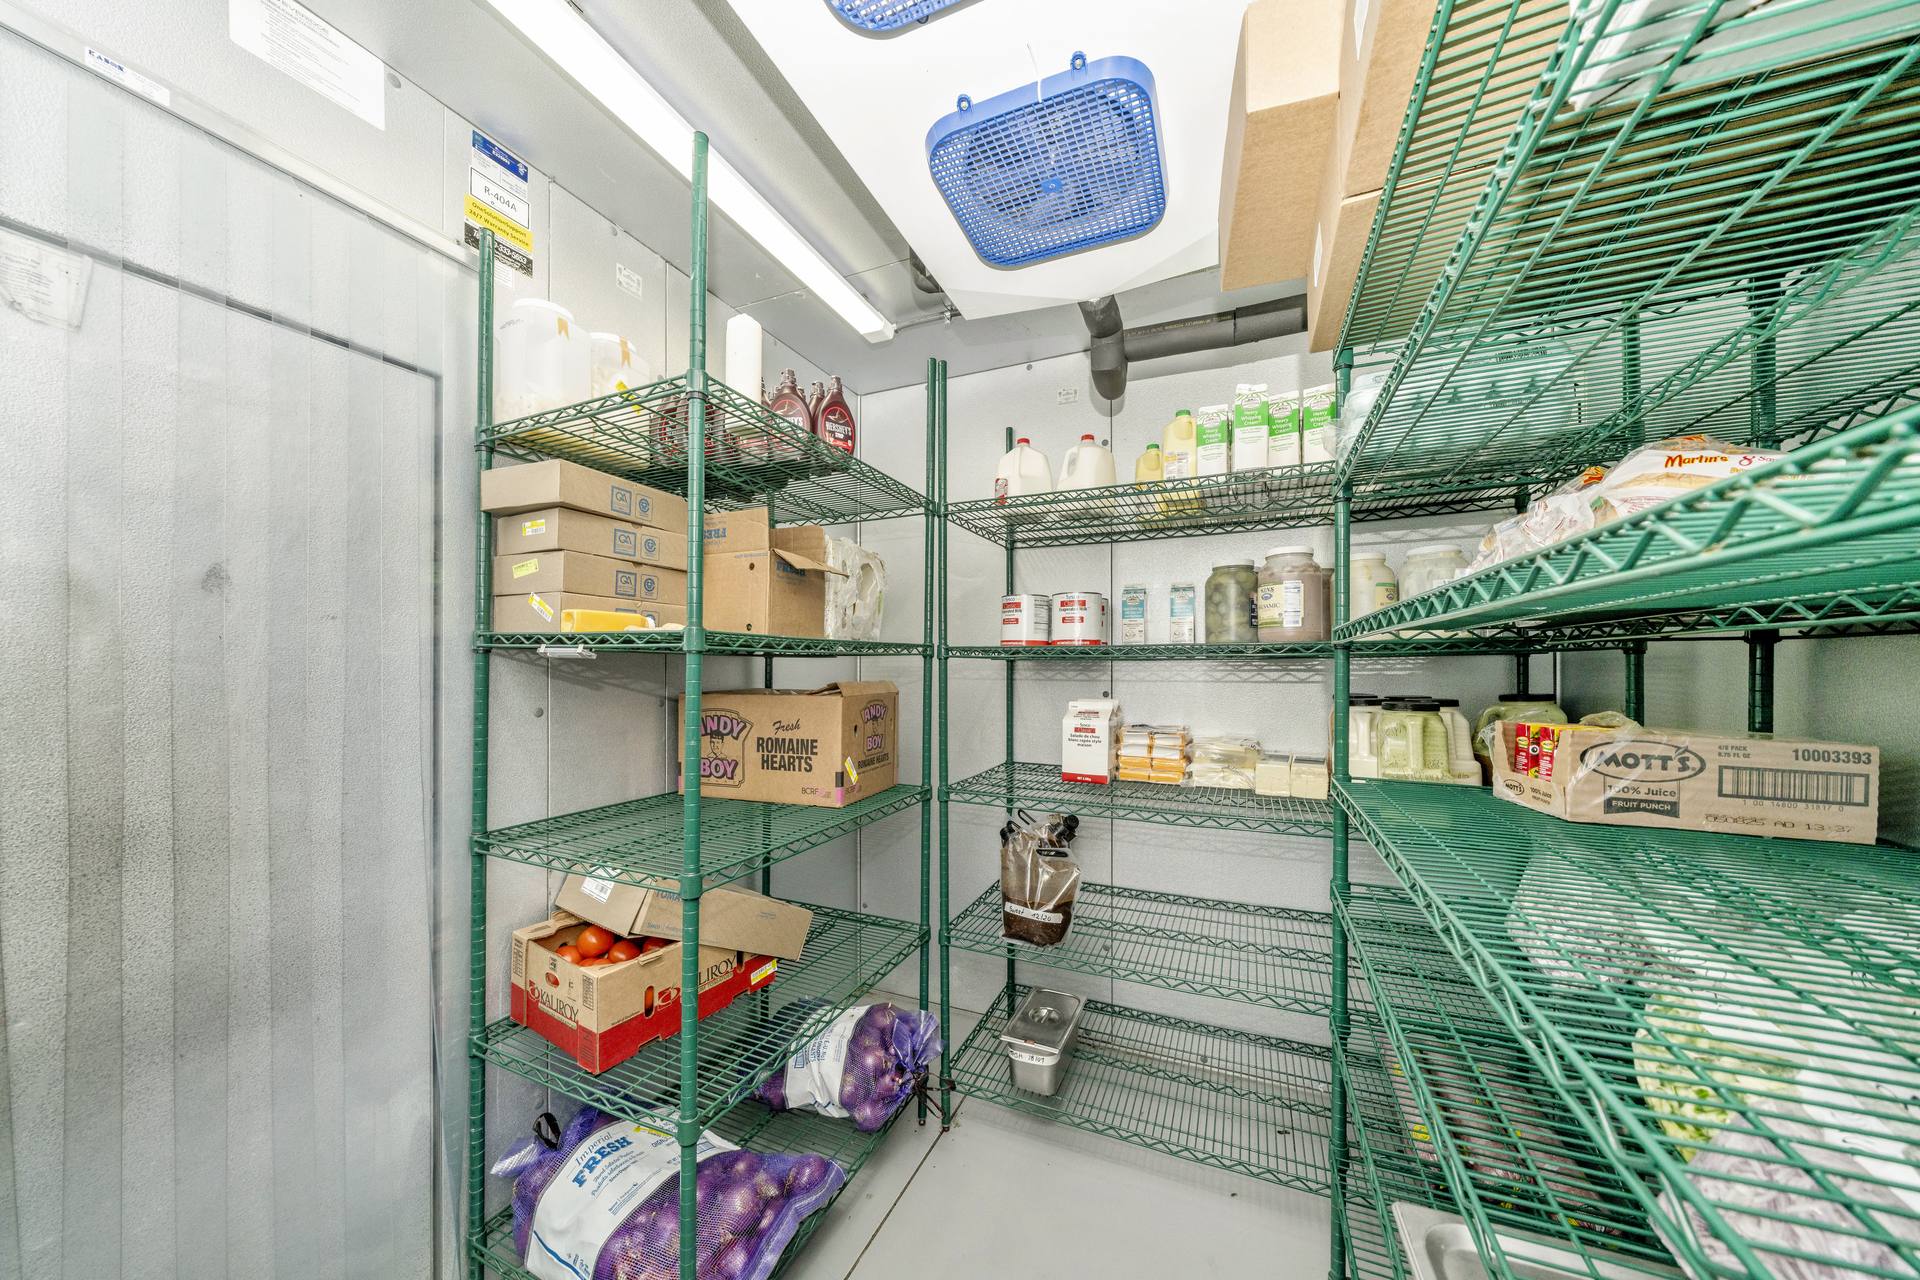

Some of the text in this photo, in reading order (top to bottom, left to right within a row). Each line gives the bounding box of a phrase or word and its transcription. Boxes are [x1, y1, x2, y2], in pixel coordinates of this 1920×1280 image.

[484, 186, 518, 213] R-404A
[469, 208, 483, 220] 24/7
[483, 217, 510, 237] Warranty
[510, 232, 530, 247] Service
[471, 201, 527, 238] OneSolutionSupport
[1664, 454, 1729, 468] Martin's
[863, 704, 887, 723] ANDY
[772, 718, 801, 736] Fresh
[756, 736, 818, 756] ROMAINE
[867, 734, 883, 751] BOY
[761, 754, 813, 773] HEARTS
[858, 752, 890, 769] ROMAINE HEARTS
[1597, 746, 1690, 773] MOTT'S
[1791, 748, 1873, 766] 10003393
[700, 756, 739, 780] BOY
[801, 787, 818, 795] BCRF
[1607, 785, 1677, 798] 100% Juice
[1612, 800, 1671, 811] FRUIT PUNCH
[540, 988, 579, 1022] KALIROY
[575, 1131, 613, 1167] Imperial
[572, 1136, 633, 1188] FRESH
